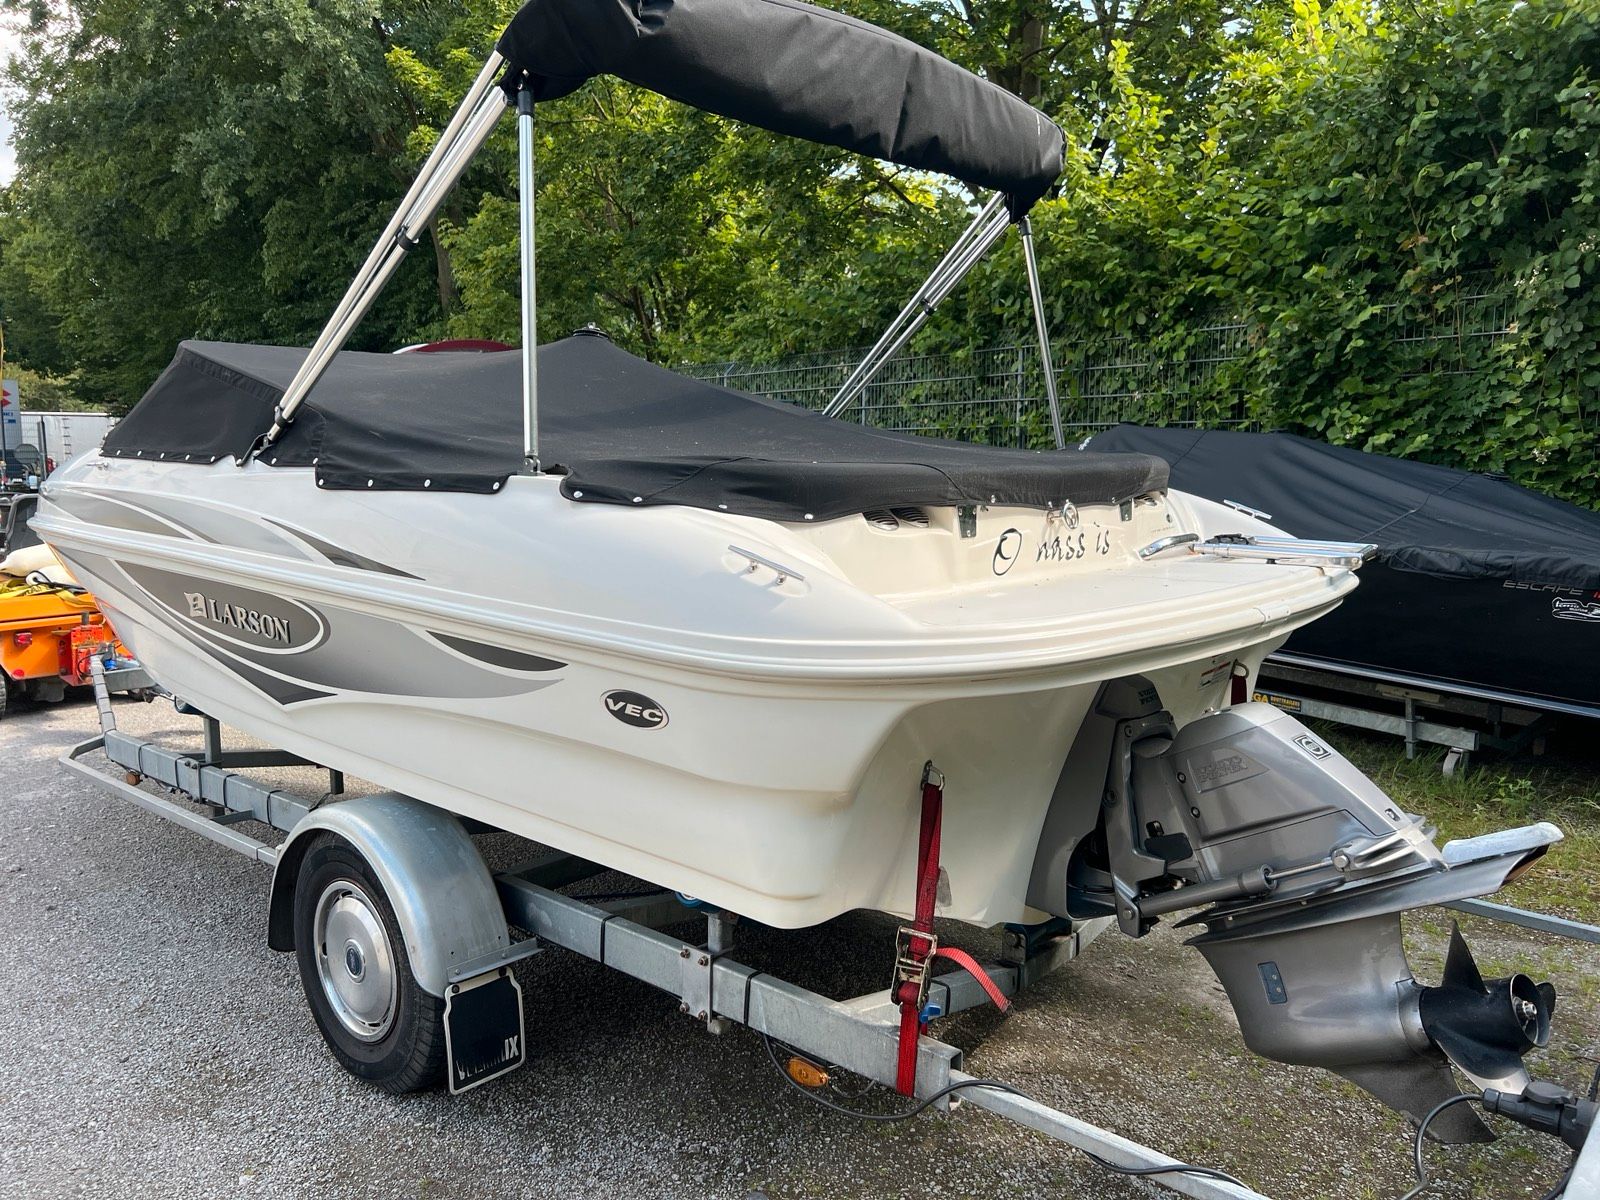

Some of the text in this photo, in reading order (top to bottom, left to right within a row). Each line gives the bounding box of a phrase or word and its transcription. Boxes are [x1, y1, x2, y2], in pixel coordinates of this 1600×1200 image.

[1503, 579, 1584, 596] ESCAPE
[209, 598, 291, 644] LARSON
[606, 697, 663, 722] VEC
